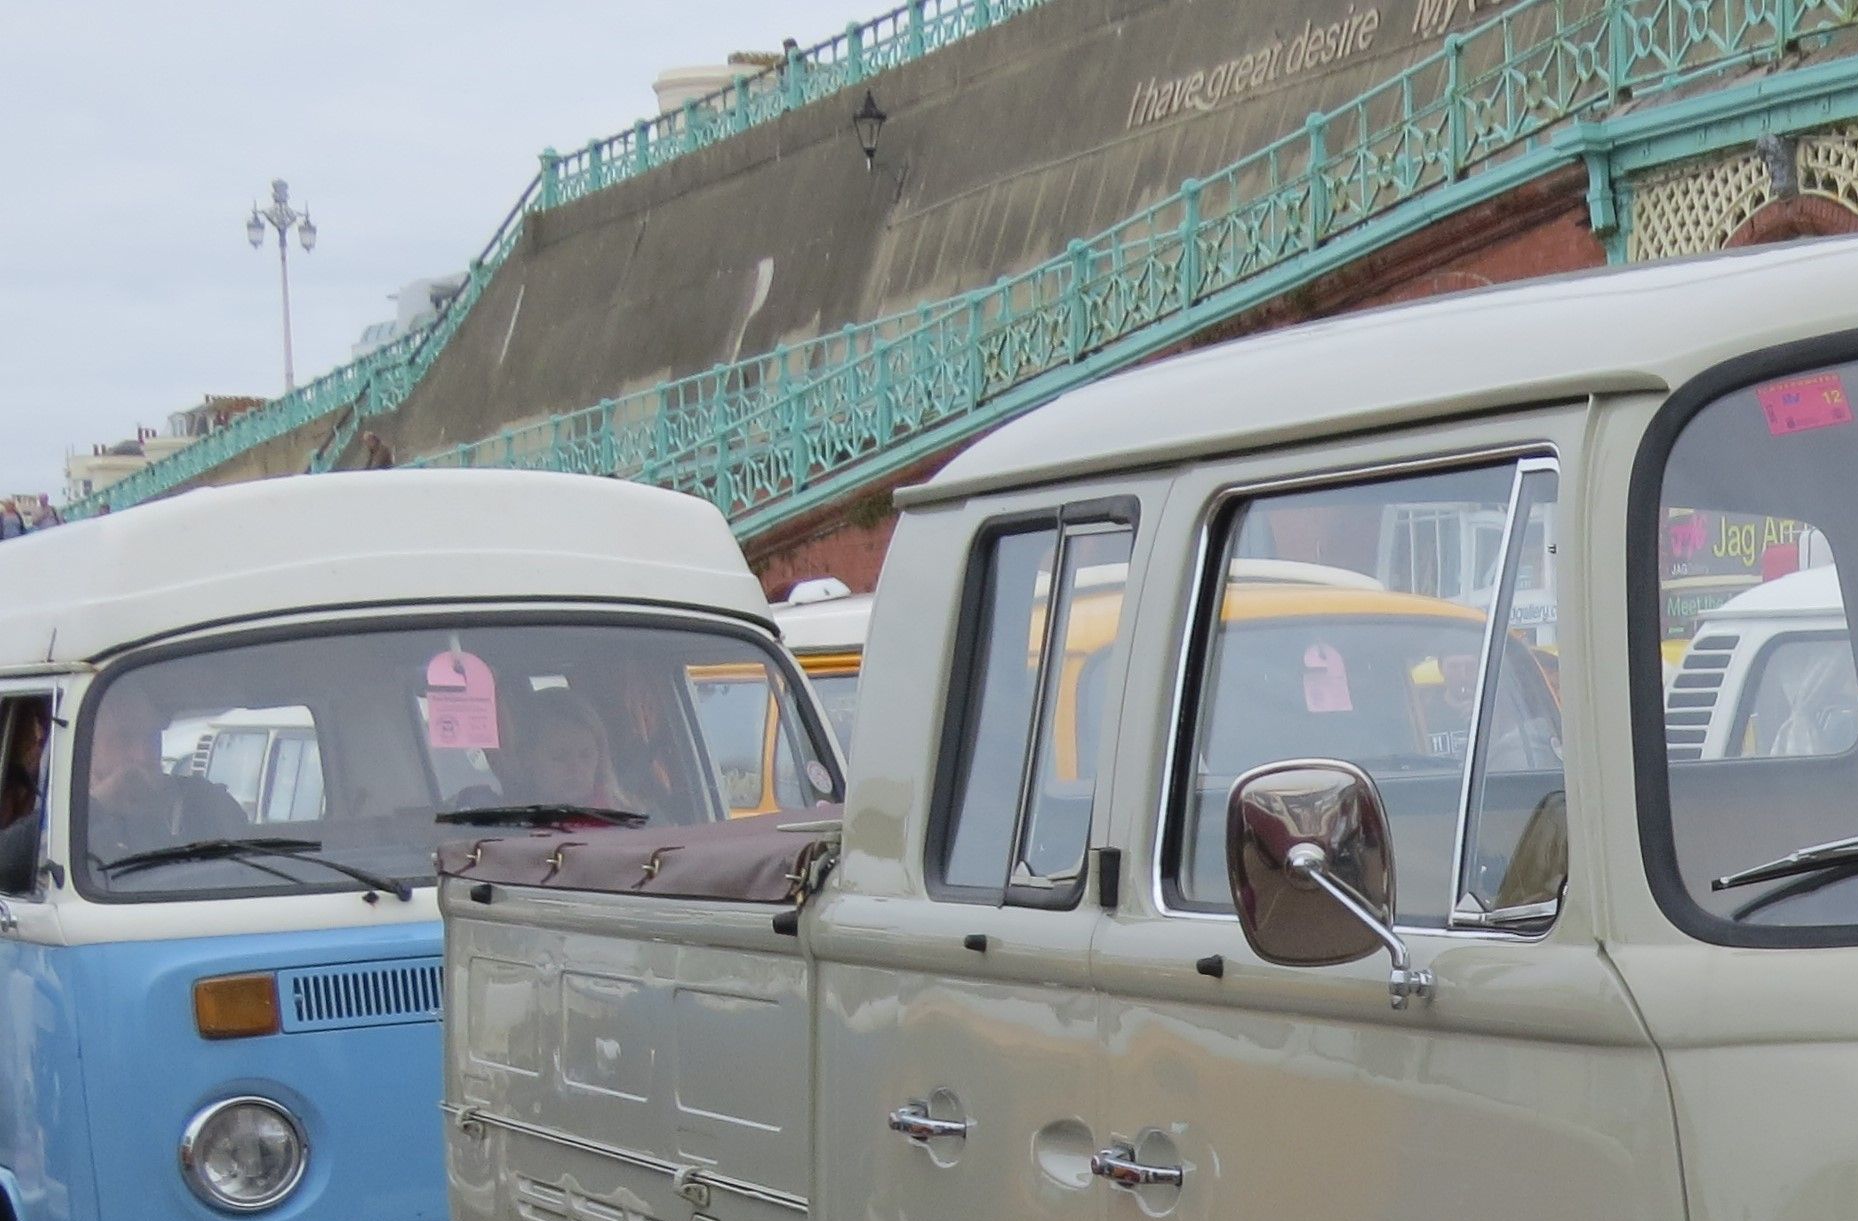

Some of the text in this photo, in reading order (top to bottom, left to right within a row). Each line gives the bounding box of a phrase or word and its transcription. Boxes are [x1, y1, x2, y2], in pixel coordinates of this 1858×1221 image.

[1126, 82, 1142, 130] I
[1139, 76, 1204, 126] have
[1195, 44, 1283, 110] great
[1286, 6, 1381, 74] desire
[1712, 515, 1756, 567] Jag
[1667, 596, 1703, 617] Meet
